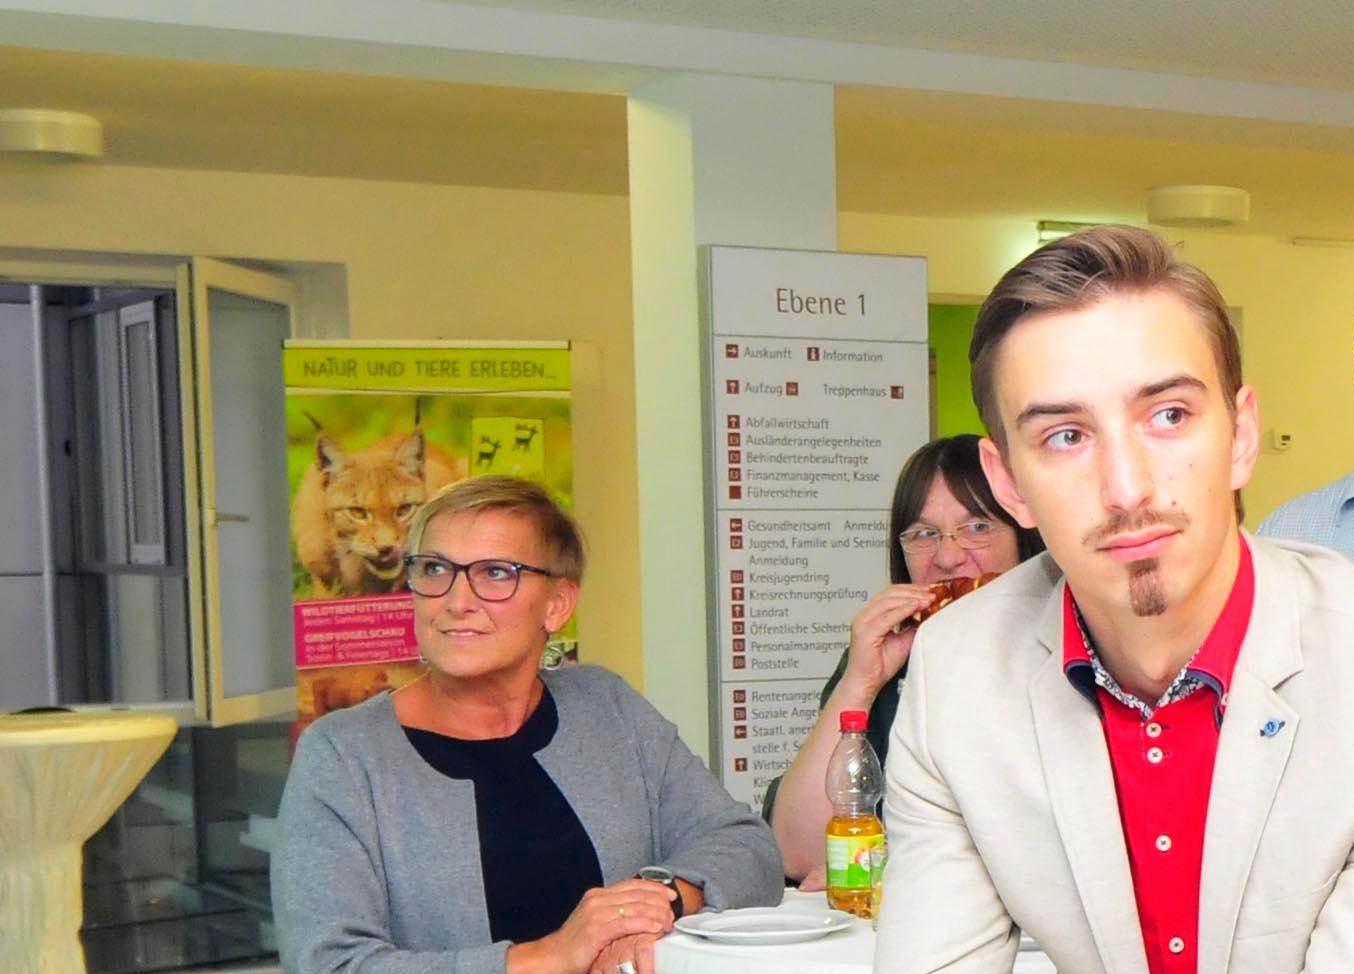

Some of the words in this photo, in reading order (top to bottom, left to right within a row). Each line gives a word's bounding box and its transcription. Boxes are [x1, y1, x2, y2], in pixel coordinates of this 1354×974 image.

[776, 288, 847, 316] Ebene
[857, 294, 866, 316] 1
[744, 347, 792, 360] Auskunft
[822, 350, 883, 363] Information
[303, 357, 358, 377] NATUR
[367, 360, 406, 377] UND
[416, 359, 461, 378] TIERE
[744, 382, 783, 397] Aufzug
[824, 384, 887, 399] Treppenhaus
[745, 416, 830, 430] Abfallwirtschaft
[745, 434, 882, 450] Ausländerangelegenheiten
[746, 452, 869, 467] Behindertenbeauftragte
[747, 469, 850, 484] Finanzmanagement,
[853, 471, 881, 483] Kasse
[747, 486, 819, 499] Führerscheine
[748, 519, 831, 532] Gesundheitsamt
[748, 537, 788, 552] Jugend,
[791, 537, 828, 549] Familie
[831, 537, 850, 549] und
[749, 555, 809, 568] Anmeldung
[750, 571, 830, 586] Kreisjugendring
[750, 588, 869, 602] Kreisrechnungsprüfung
[750, 606, 789, 618] Landrat
[750, 622, 809, 635] Öffentliche
[751, 657, 799, 670] Poststelle
[752, 708, 789, 720] Soziale
[752, 725, 785, 737] Staatl.
[752, 742, 781, 754] stelle
[782, 742, 791, 753] f.
